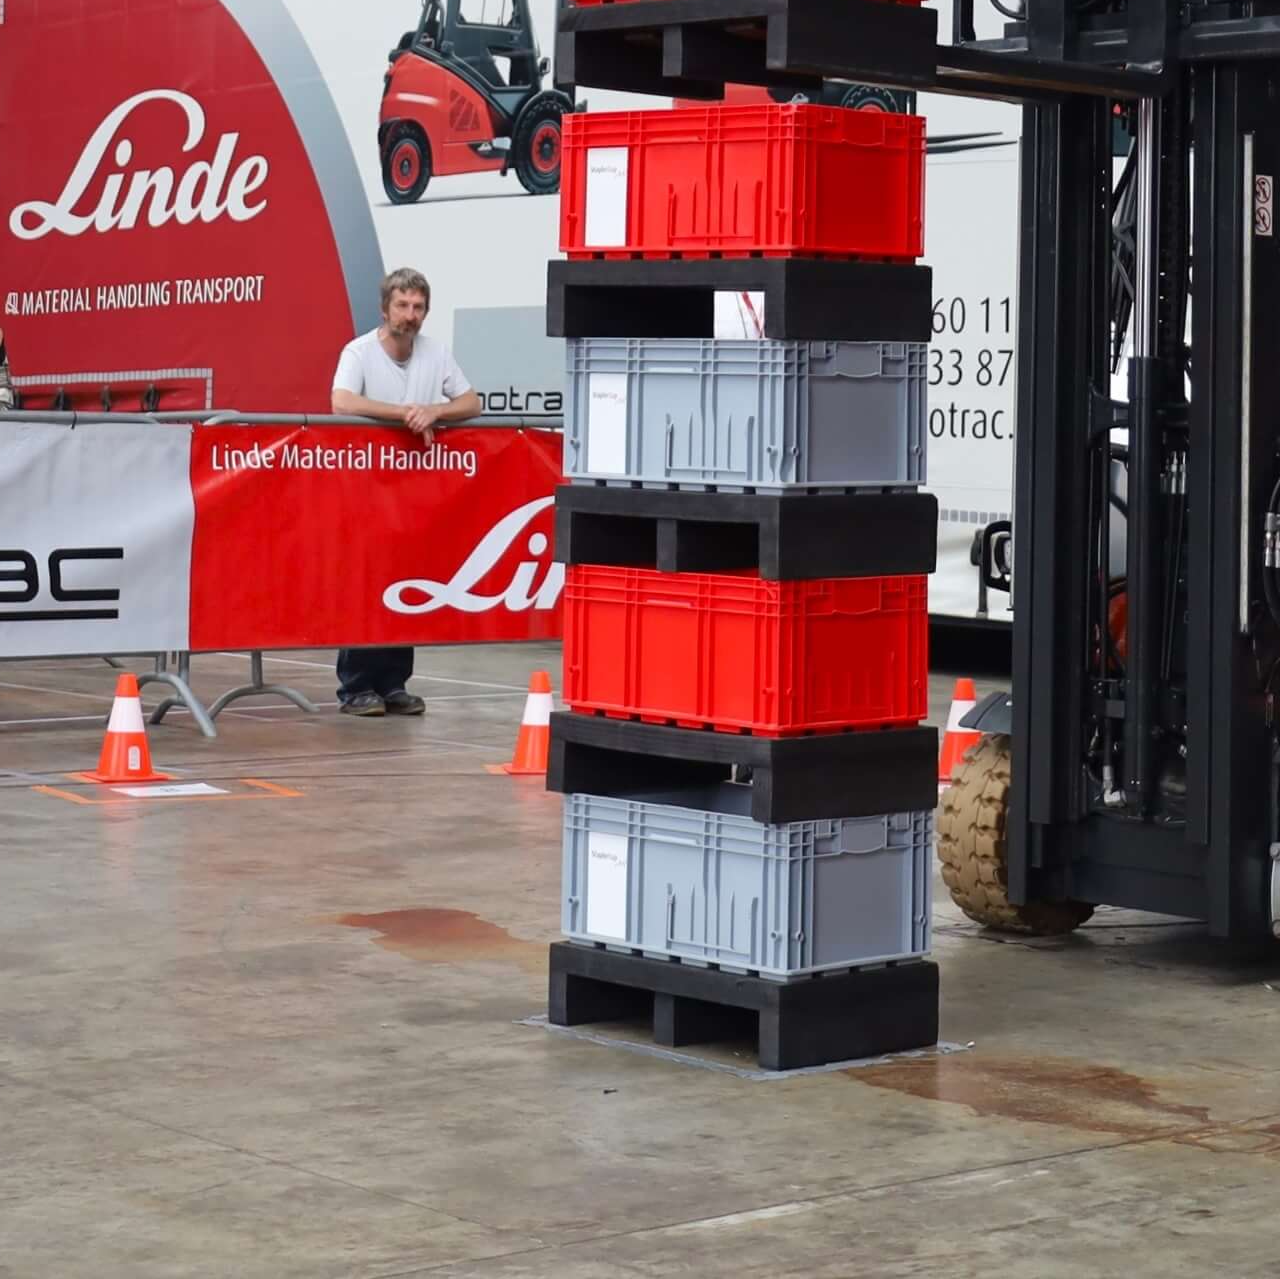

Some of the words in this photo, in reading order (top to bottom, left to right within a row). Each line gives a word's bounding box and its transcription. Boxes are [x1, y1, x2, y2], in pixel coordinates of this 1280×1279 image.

[9, 89, 268, 240] Linde
[21, 287, 92, 316] MATERIAL
[96, 281, 171, 311] HANDLING
[175, 275, 265, 305] TRANSPORT
[931, 296, 966, 334] 60
[980, 296, 1010, 334] 11
[928, 349, 963, 386] 33
[976, 349, 1014, 386] 87
[212, 442, 276, 471] Linde
[280, 441, 373, 470] Material
[379, 442, 477, 477] Handling
